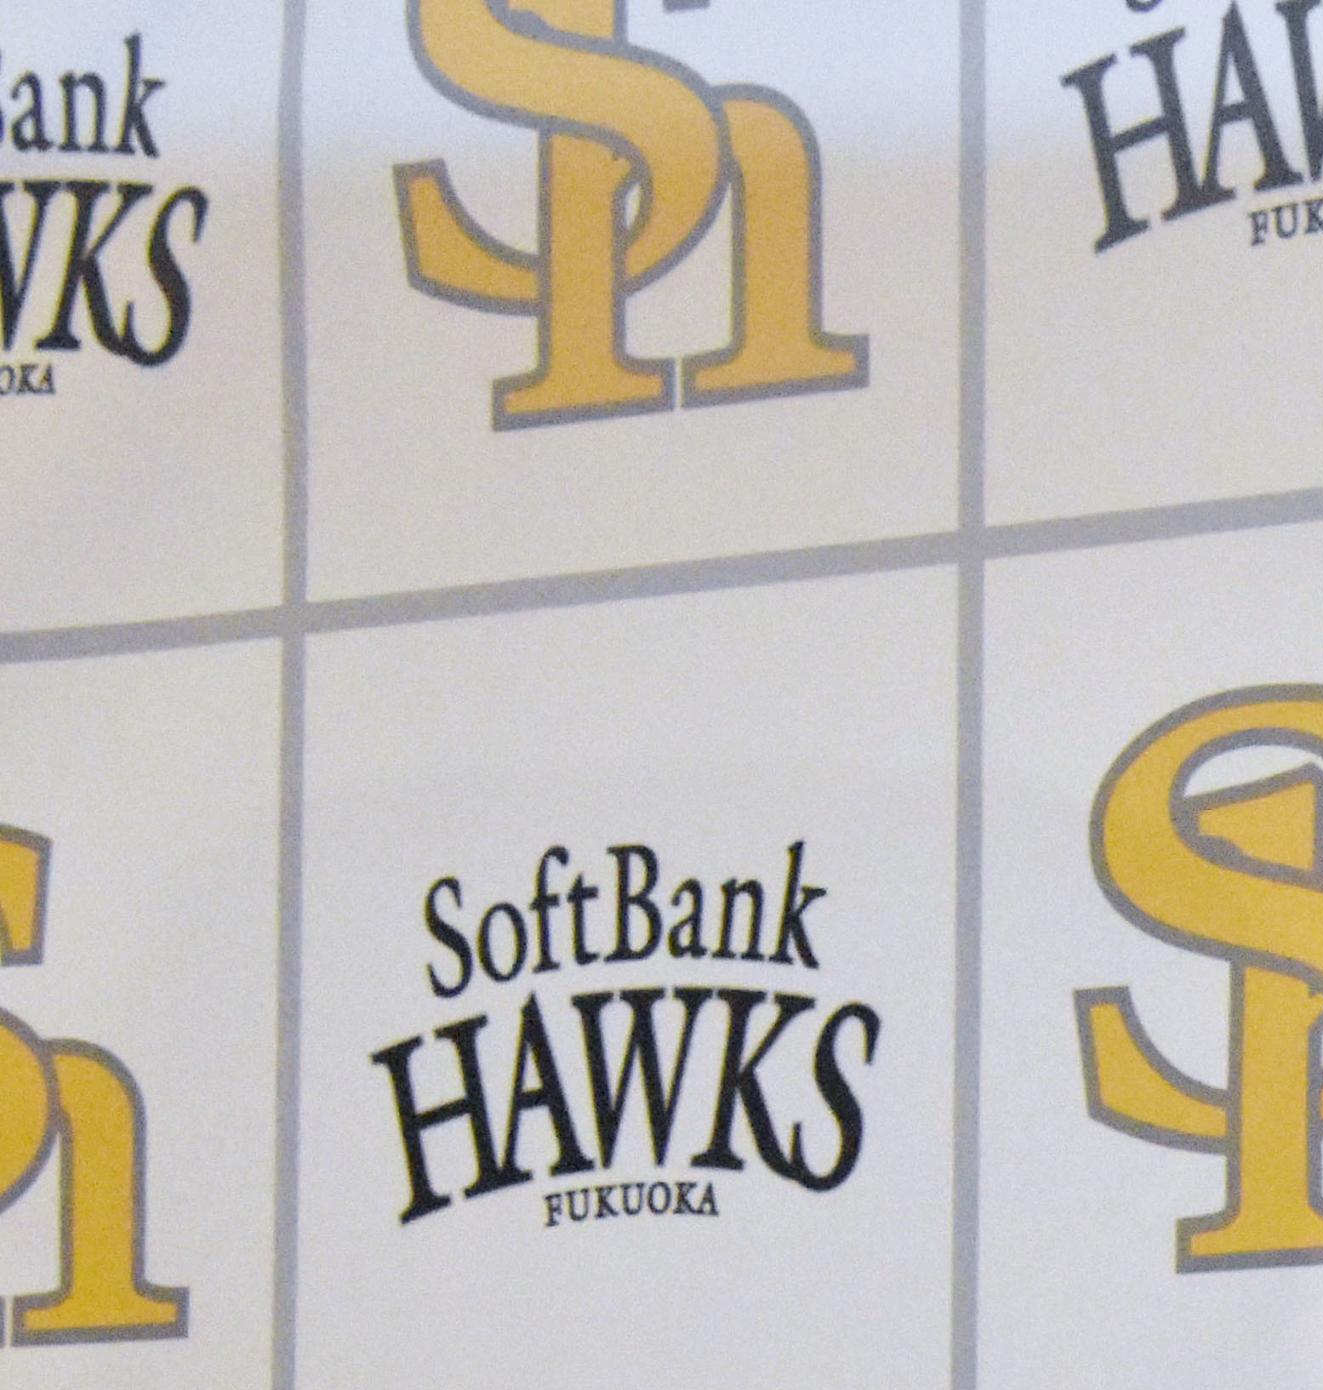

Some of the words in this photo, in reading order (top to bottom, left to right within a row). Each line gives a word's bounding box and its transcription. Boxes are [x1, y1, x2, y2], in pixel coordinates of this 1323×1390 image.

[424, 839, 828, 1000] SoftBank
[370, 985, 882, 1226] HAWKS
[544, 1181, 720, 1228] FUKUOKA
